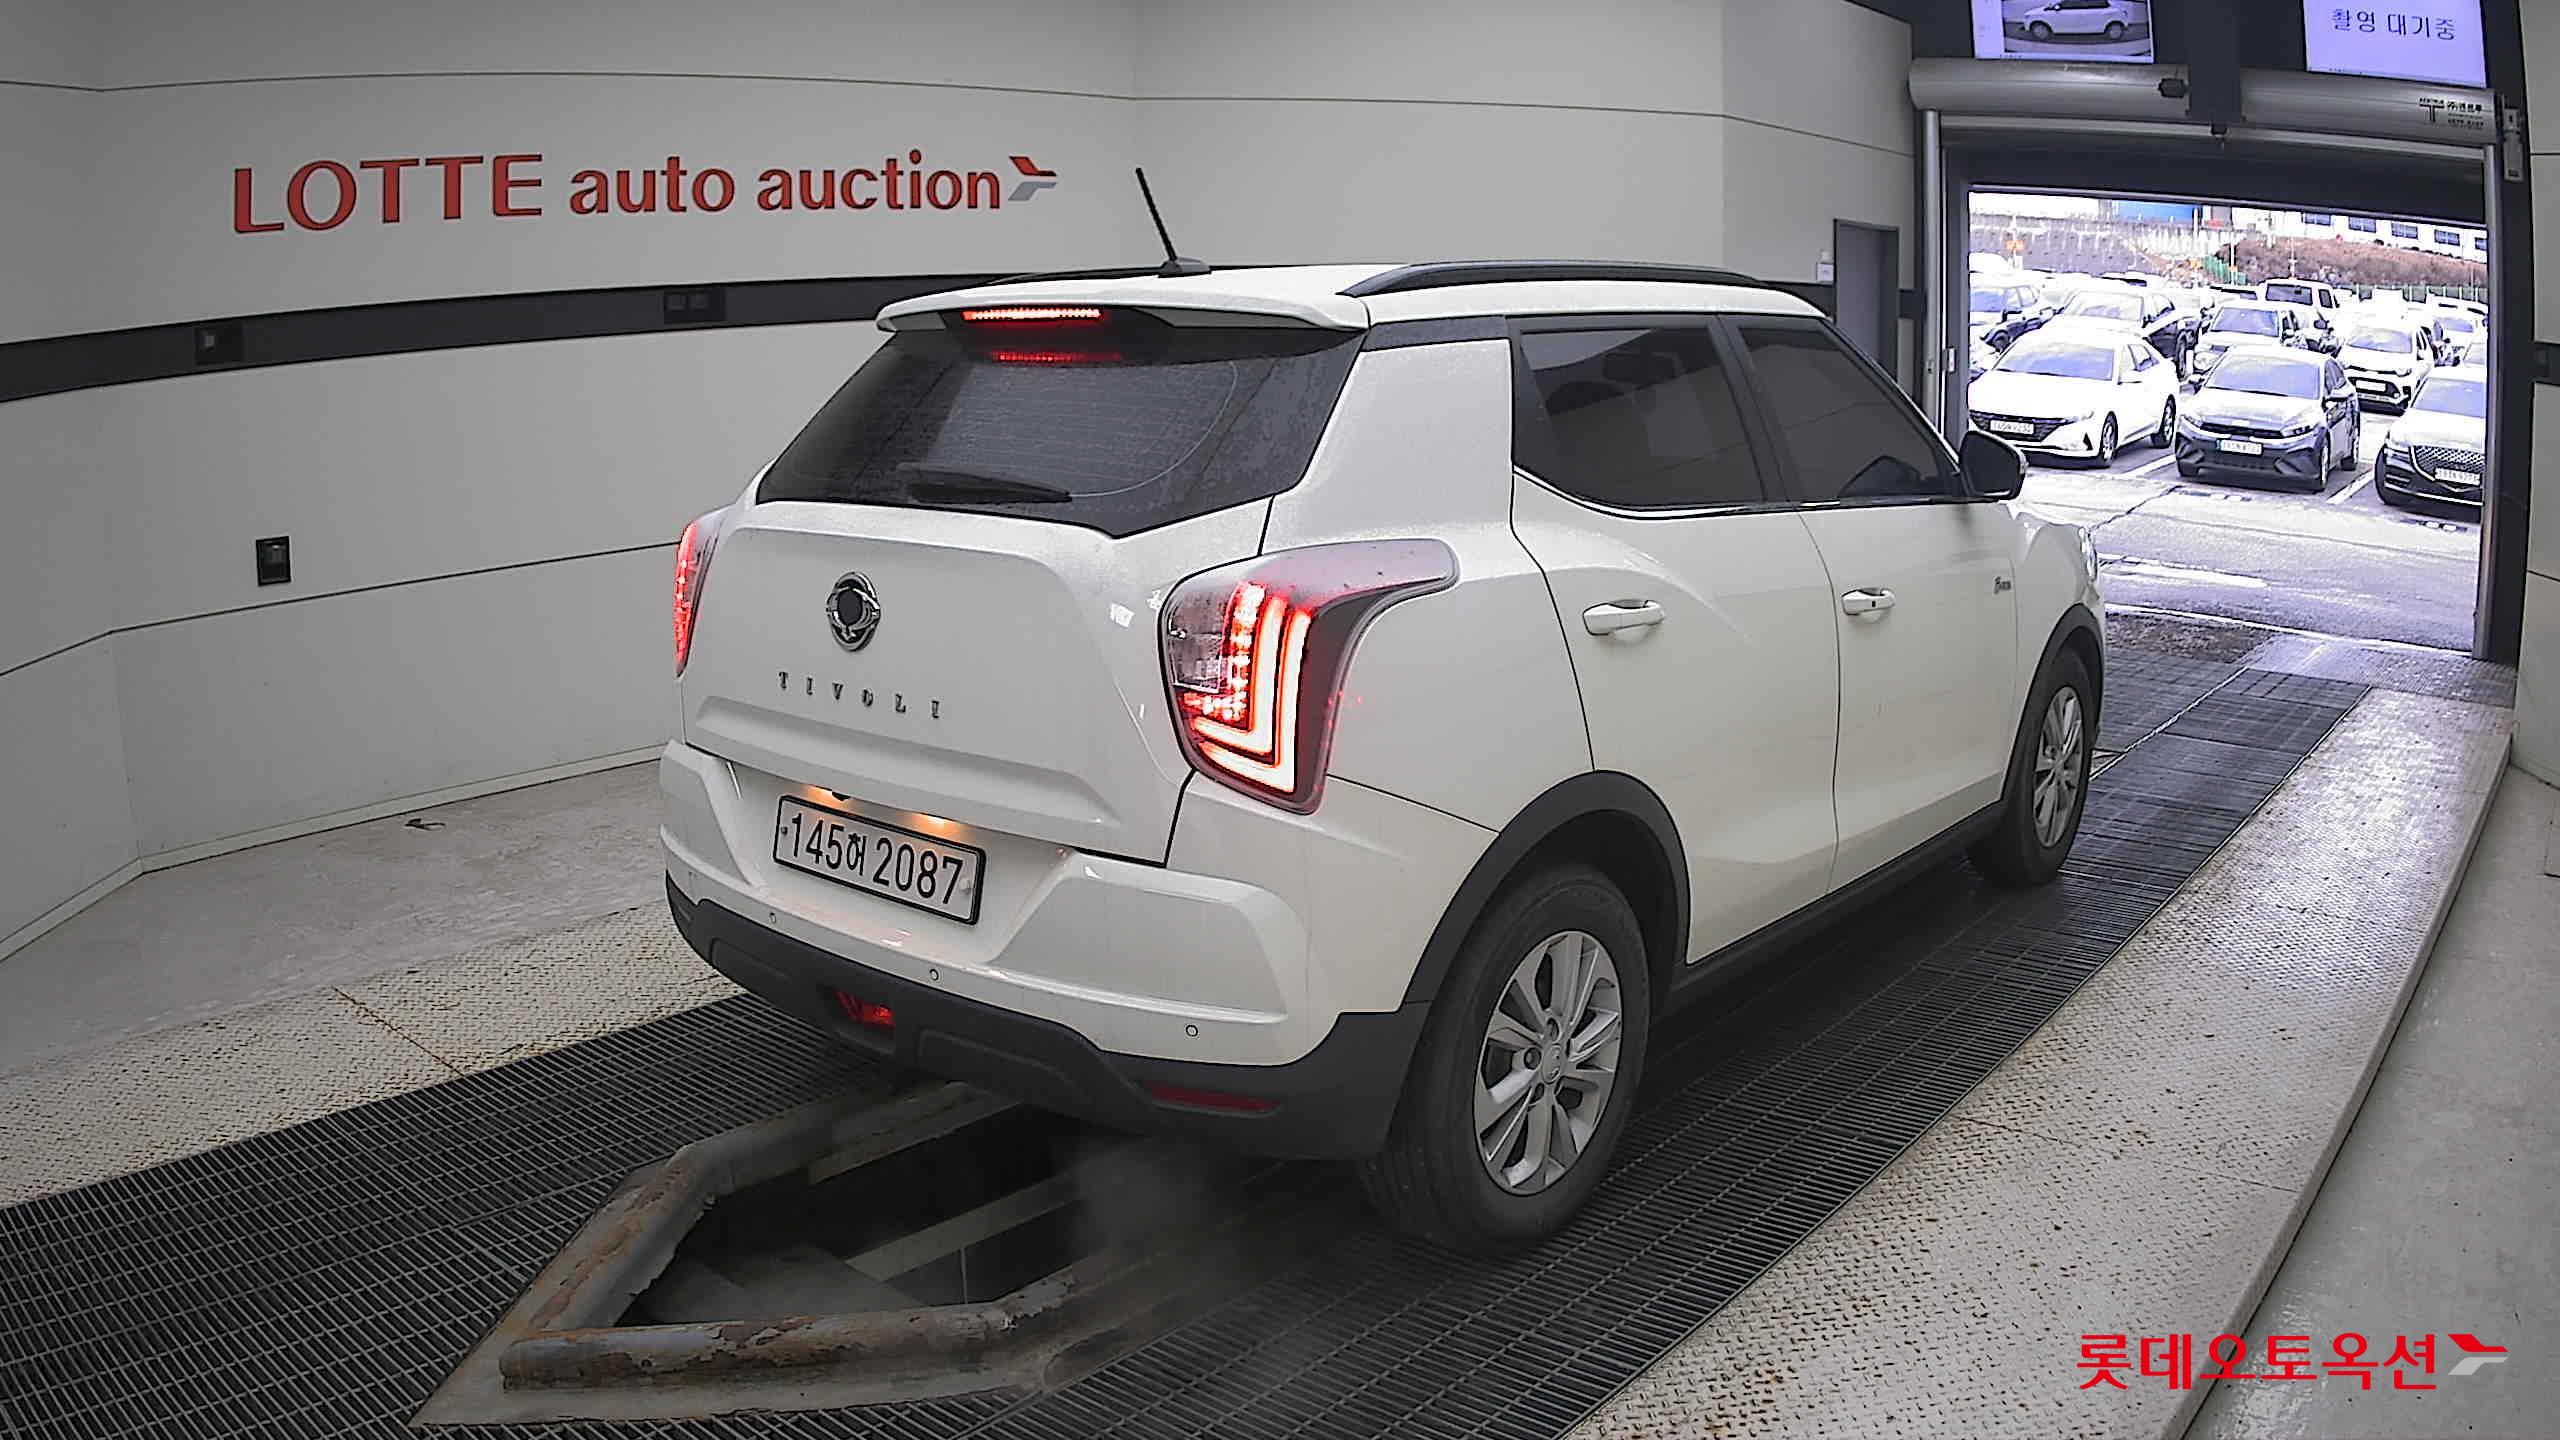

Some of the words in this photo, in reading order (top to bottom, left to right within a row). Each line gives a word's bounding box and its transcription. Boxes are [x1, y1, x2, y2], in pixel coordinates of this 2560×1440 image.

[2332, 8, 2376, 33] 촬영
[2387, 13, 2456, 40] 대기중
[233, 154, 543, 234] LOTTE
[568, 156, 736, 214] auto
[756, 149, 1001, 211] auction
[777, 671, 942, 720] TIVOLI
[791, 812, 867, 877] 145허
[872, 837, 964, 905] 2087
